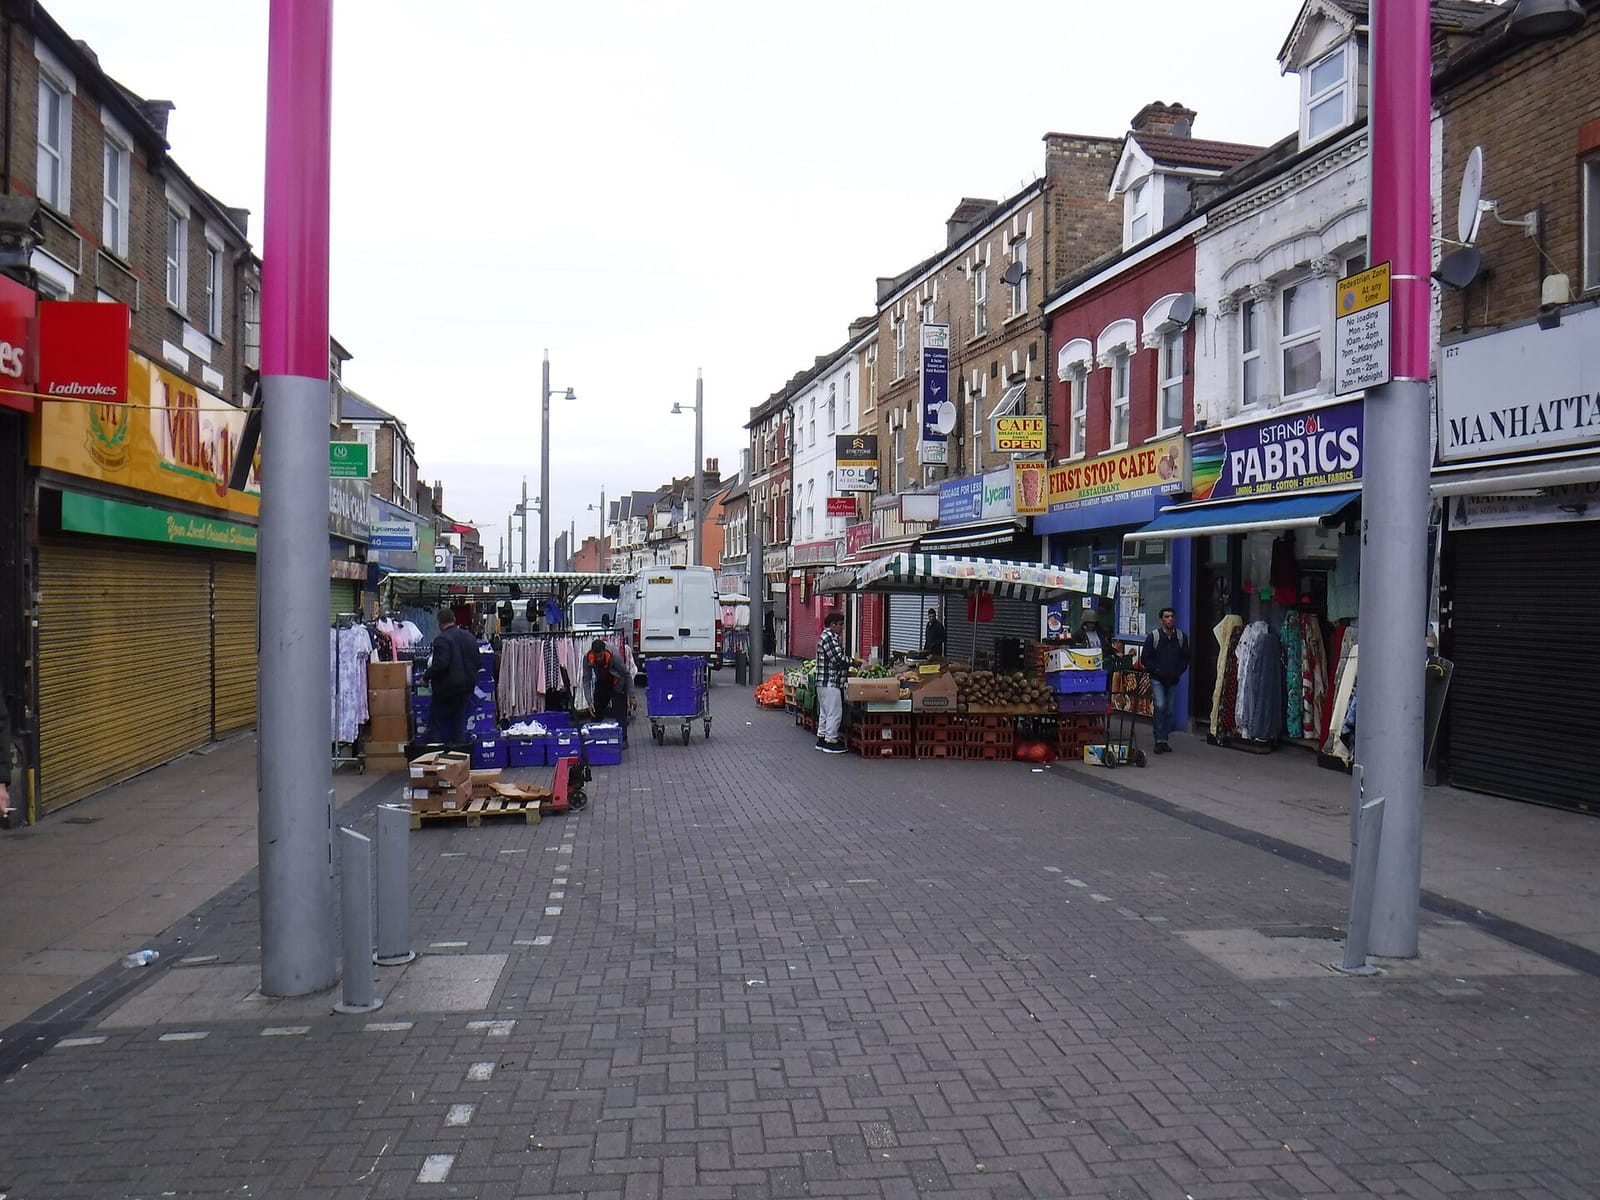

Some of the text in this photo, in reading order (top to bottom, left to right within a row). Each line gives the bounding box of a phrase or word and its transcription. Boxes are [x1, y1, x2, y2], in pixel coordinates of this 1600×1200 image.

[1339, 267, 1387, 290] Pedestrian Zone
[1361, 282, 1382, 294] At any
[1365, 292, 1379, 303] time
[1346, 311, 1379, 327] No loading
[1348, 326, 1361, 336] Mon
[1365, 321, 1376, 331] Sat
[1346, 335, 1361, 347] 10am
[1365, 330, 1379, 343] 4pm
[1341, 348, 1354, 358] 7pm
[1357, 339, 1384, 352] Midnight
[1446, 346, 1460, 358] 177
[1351, 353, 1373, 365] Sunday
[1346, 366, 1361, 377] 10am
[1365, 361, 1379, 373] 2pm
[1341, 378, 1353, 388] 7pm
[1357, 370, 1384, 384] Midnight
[48, 381, 117, 396] Ladbrokes
[996, 418, 1043, 432] CAFE
[1450, 391, 1600, 448] MANHATTA
[1259, 413, 1325, 445] ISTANBUL
[1000, 440, 1041, 449] OPEN
[1231, 427, 1360, 486] FABRICS
[840, 468, 878, 478] TO LT
[1049, 467, 1082, 495] FIRST
[1084, 459, 1116, 488] STOP
[1119, 449, 1157, 480] CAFE
[940, 481, 982, 500] LUGGAGE FOR LESS
[1078, 482, 1121, 498] RESTAURANT
[1235, 470, 1354, 496] LINING SATIN COTTON SPECIAL FABRICS
[1130, 487, 1153, 498] TAKEAWAY
